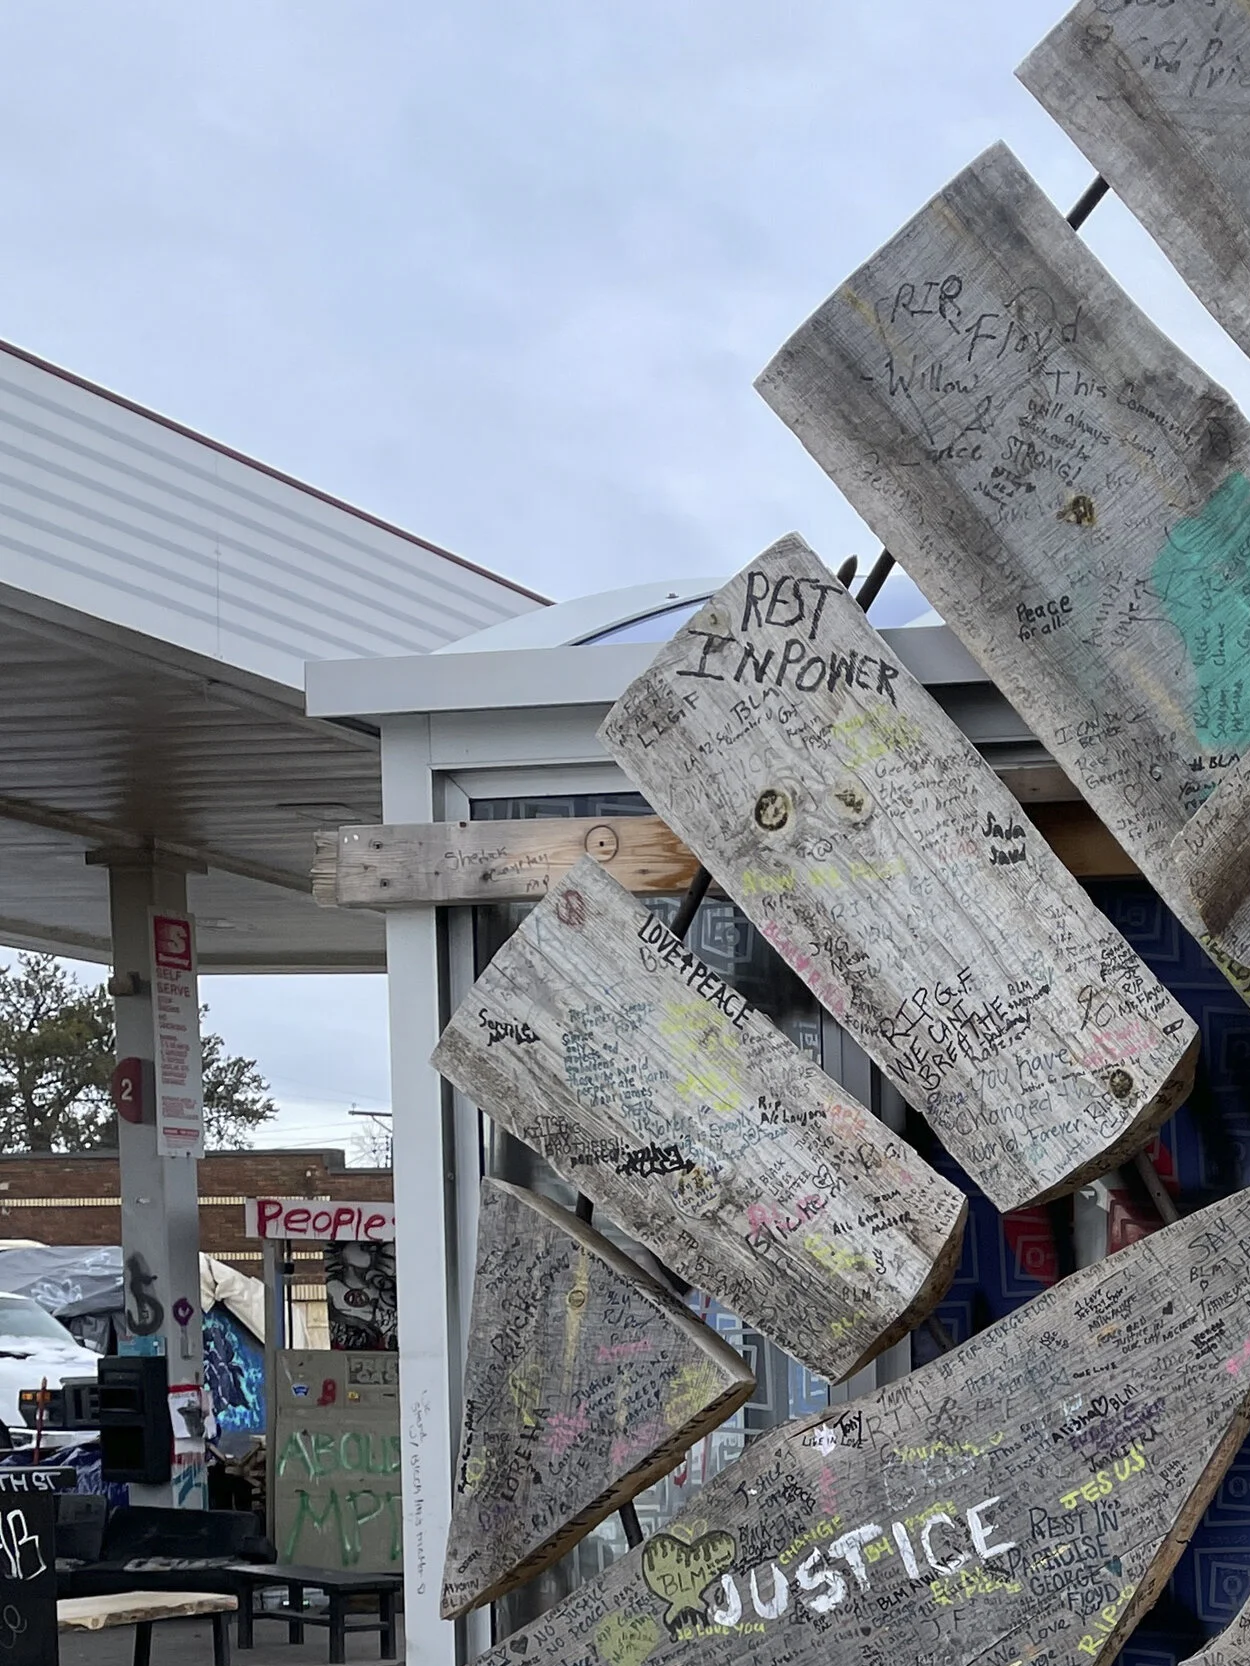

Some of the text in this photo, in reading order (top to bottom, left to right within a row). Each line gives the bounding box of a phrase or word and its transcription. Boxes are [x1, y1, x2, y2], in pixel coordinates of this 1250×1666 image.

[741, 570, 843, 640] REST
[1015, 595, 1074, 624] Peace
[676, 629, 899, 709] IN POWER
[156, 968, 182, 983] SELF
[638, 913, 685, 966] LOVE
[686, 965, 754, 1030] PEACE
[157, 981, 191, 998] SERVE
[886, 1036, 930, 1084] WE
[1017, 1047, 1072, 1079] have
[120, 1078, 133, 1101] 2
[257, 1200, 396, 1242] People
[1188, 1217, 1237, 1264] SAY
[1110, 1384, 1139, 1411] BLM
[1060, 1445, 1146, 1510] JESUS
[1029, 1506, 1087, 1540] REST
[709, 1496, 1016, 1627] JUSTICE
[657, 1569, 707, 1594] BLM
[1029, 1563, 1104, 1596] GEORGE
